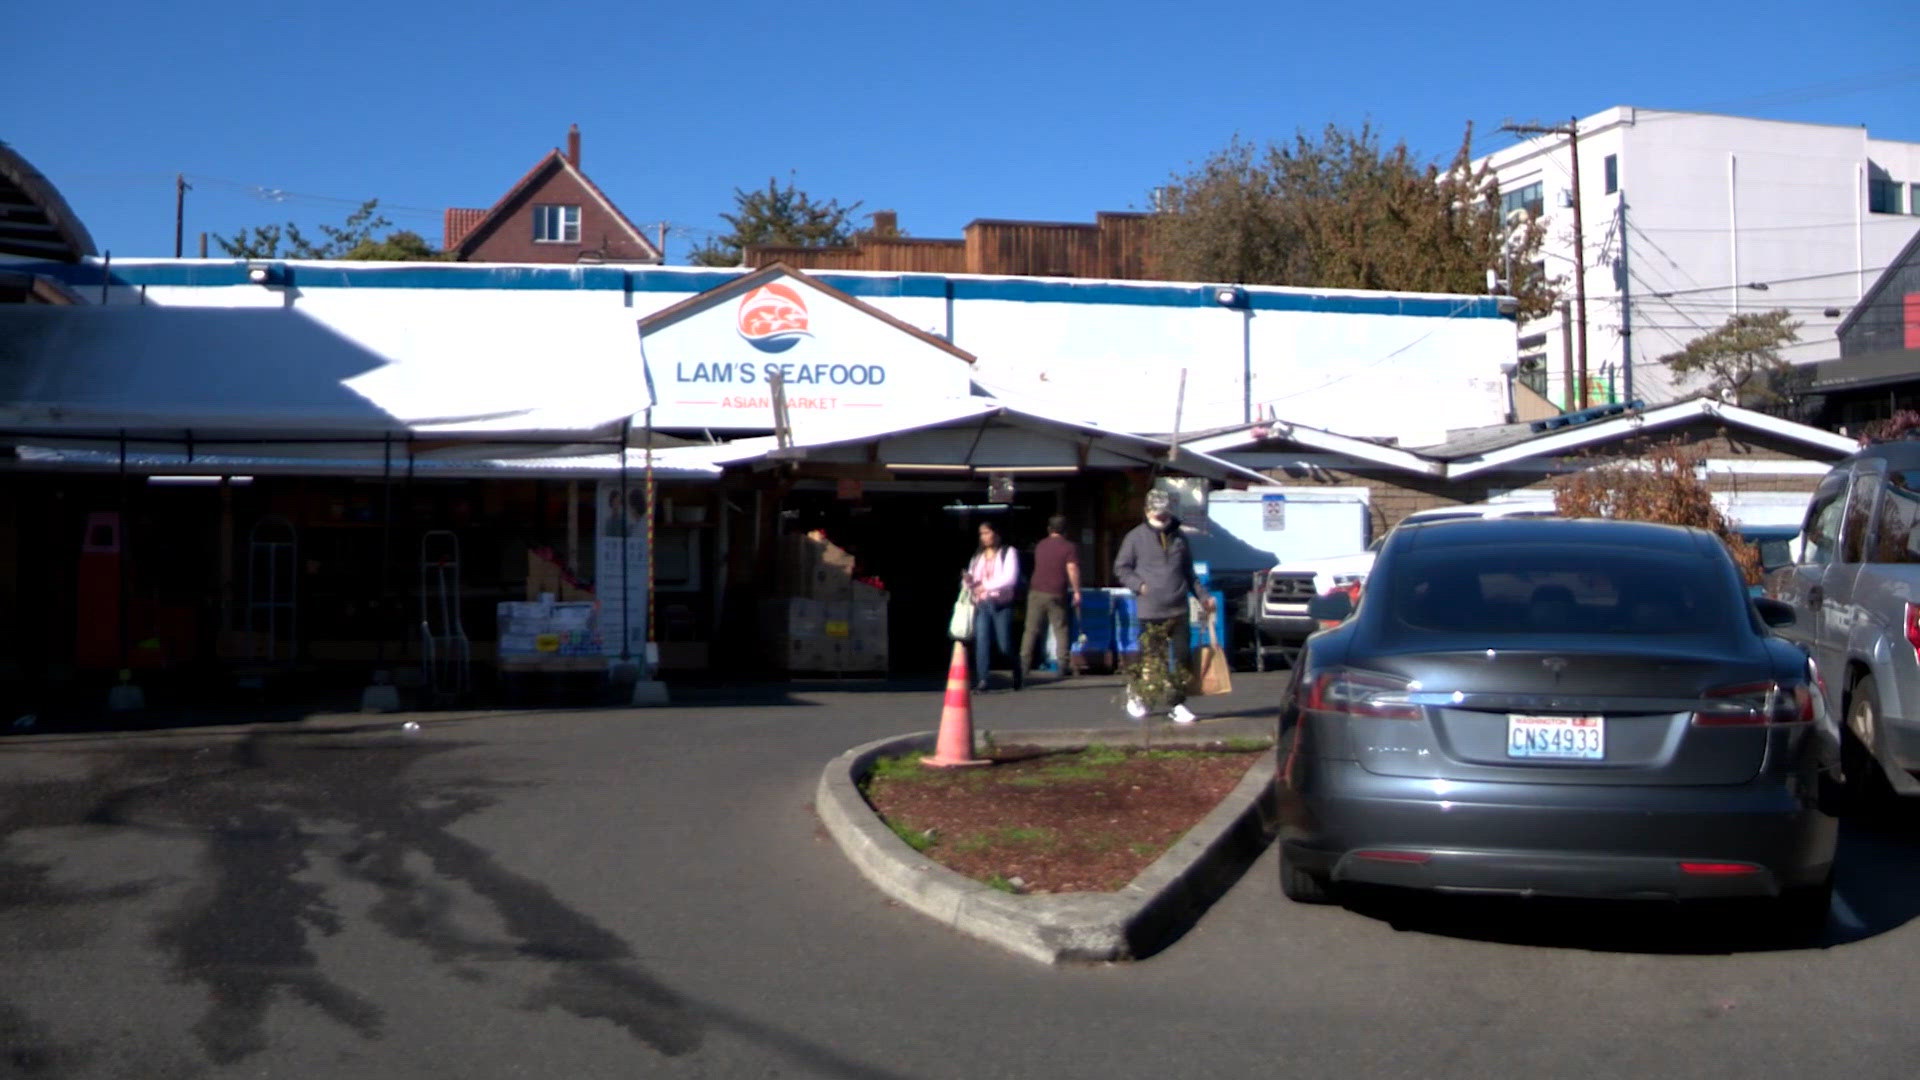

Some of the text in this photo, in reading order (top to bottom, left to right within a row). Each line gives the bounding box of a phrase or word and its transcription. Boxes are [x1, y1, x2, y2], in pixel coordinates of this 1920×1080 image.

[676, 362, 886, 386] LAM'S SEAFOOD
[721, 396, 838, 410] ASIAN ARKET
[1513, 727, 1599, 751] CNS4933
